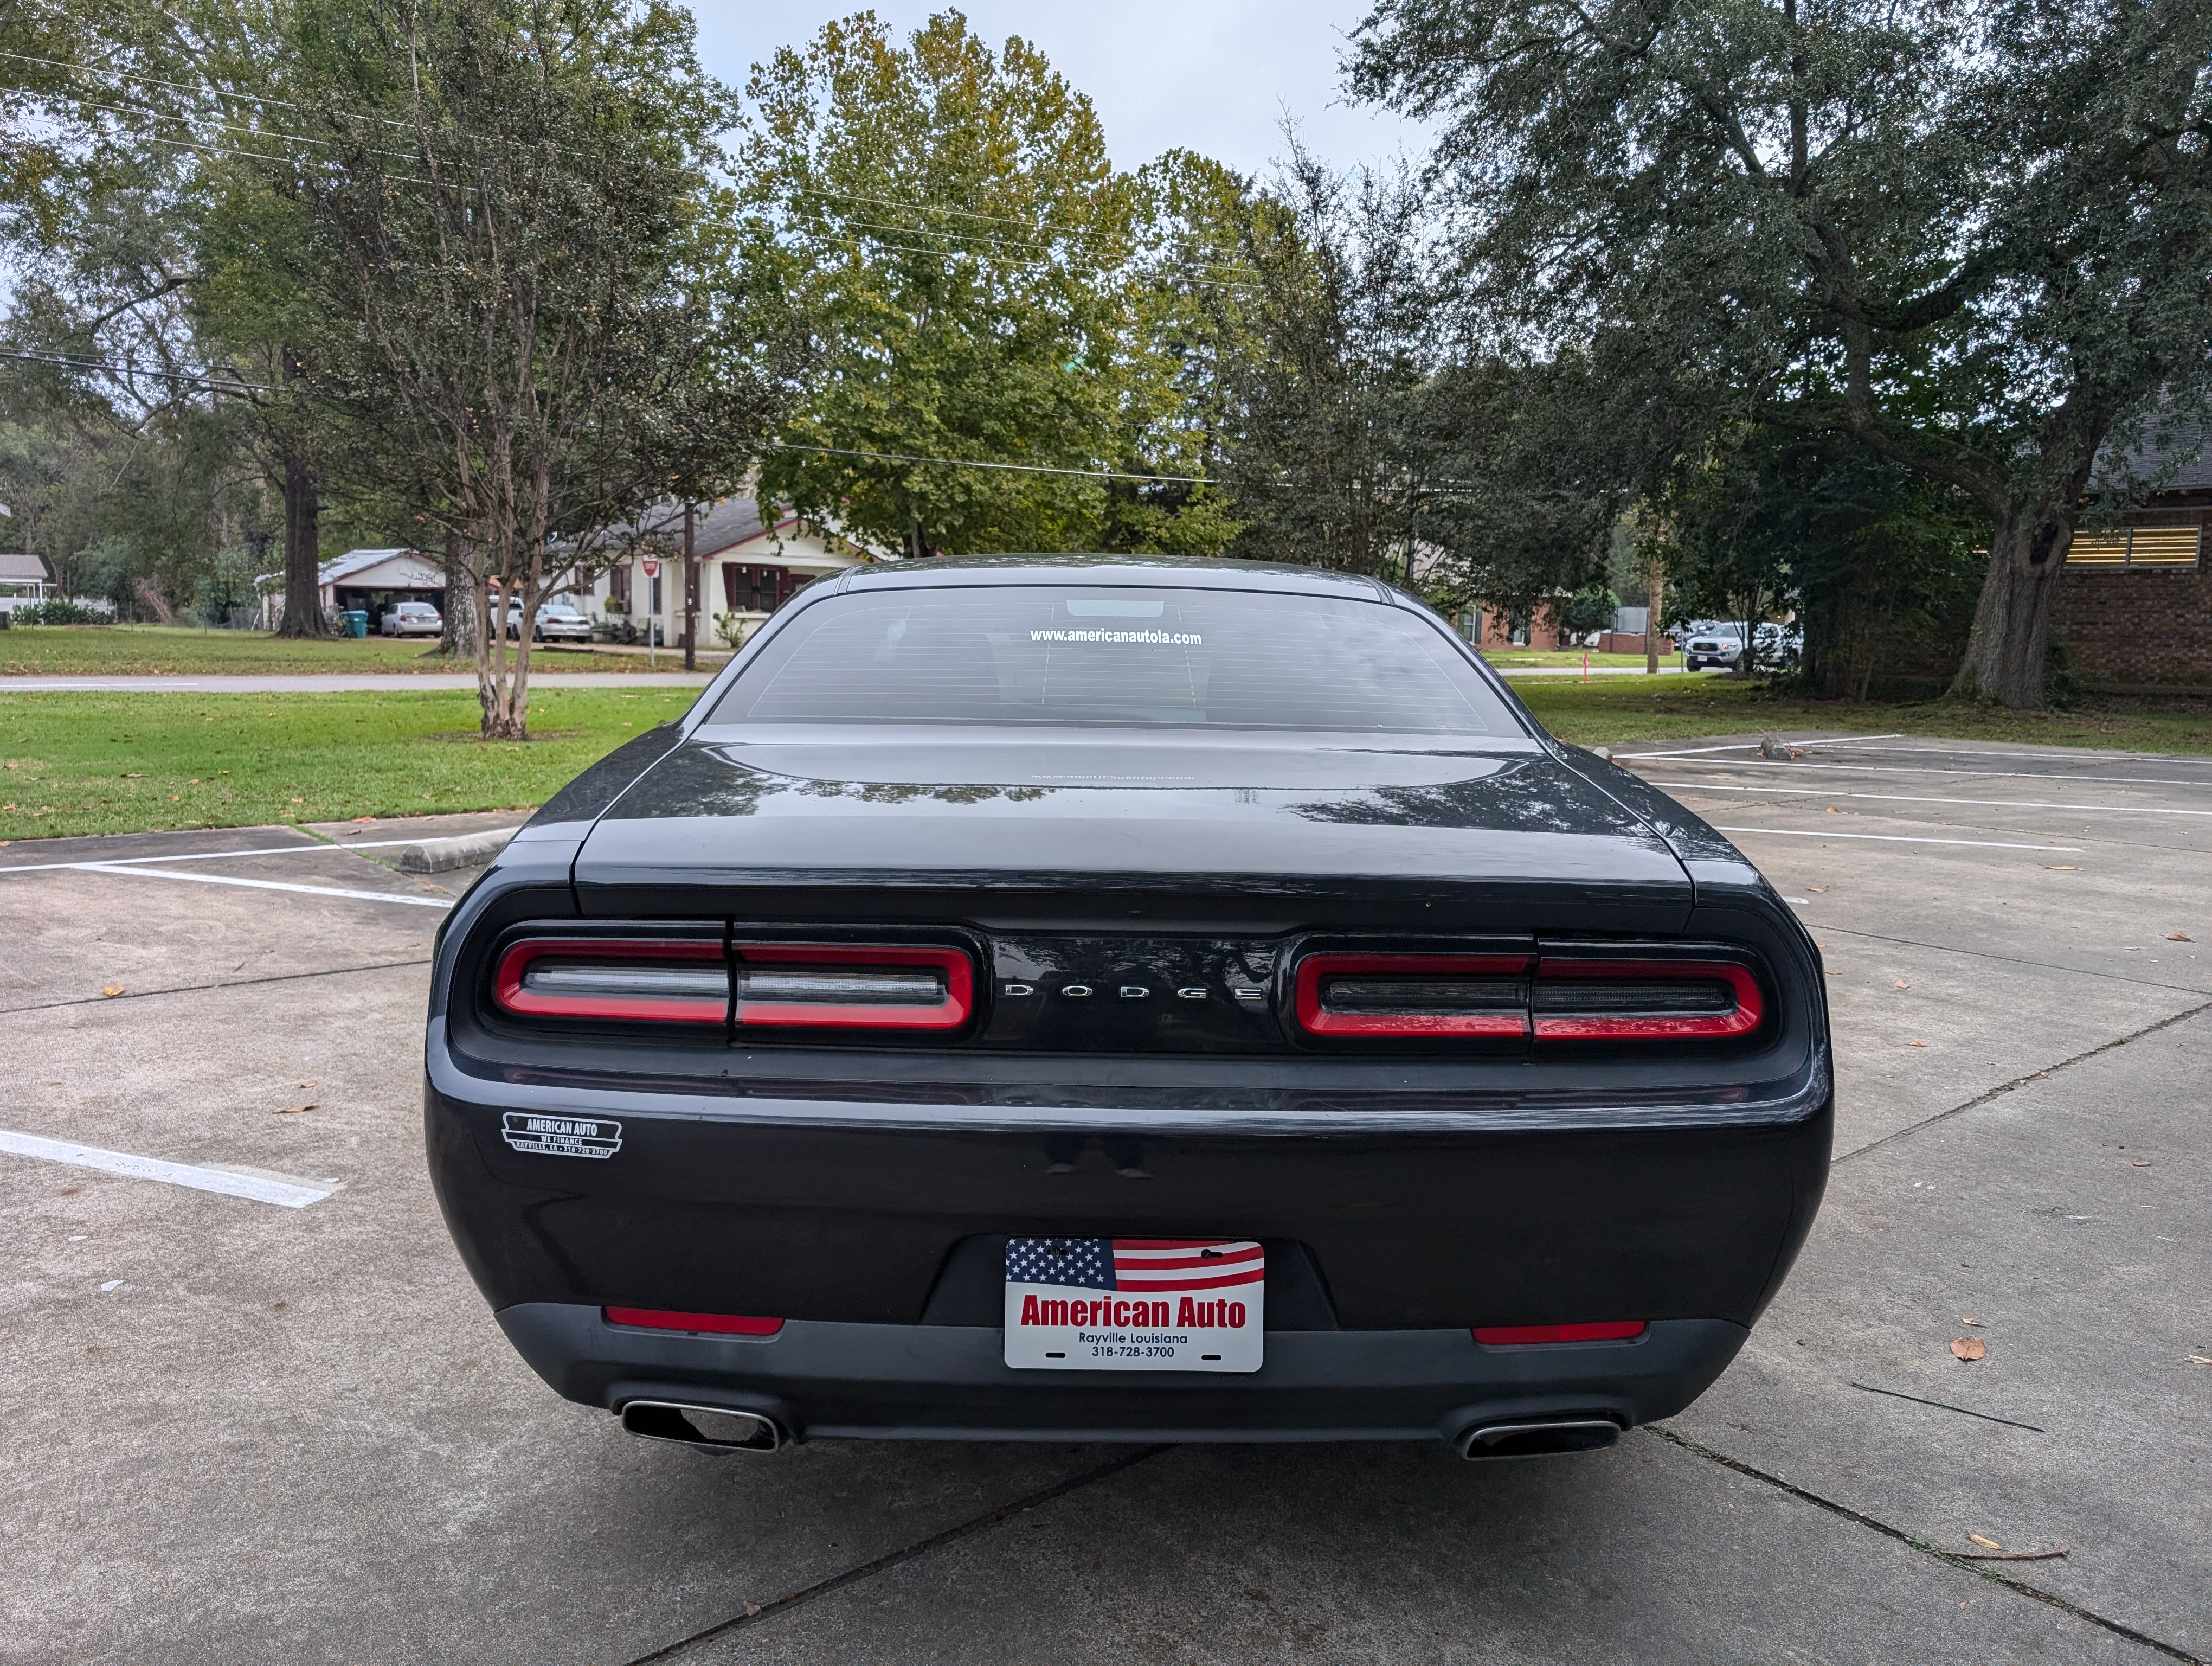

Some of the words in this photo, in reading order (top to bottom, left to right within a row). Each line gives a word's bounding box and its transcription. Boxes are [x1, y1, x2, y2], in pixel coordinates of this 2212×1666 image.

[1030, 627, 1202, 645] www.americanautola.com
[1005, 984, 1262, 999] DODGE
[526, 1118, 573, 1135] AMERICAN
[574, 1123, 597, 1137] AUTO
[553, 1136, 583, 1145] FINANCE
[516, 1142, 549, 1151] RAYVILLE,
[564, 1146, 607, 1156] 318-728-3700
[1020, 1294, 1170, 1328] American
[1176, 1296, 1246, 1328] Auto
[1078, 1332, 1127, 1346] Rayville
[1130, 1332, 1188, 1344] Louisiana
[1091, 1347, 1174, 1358] 318-728-3700
